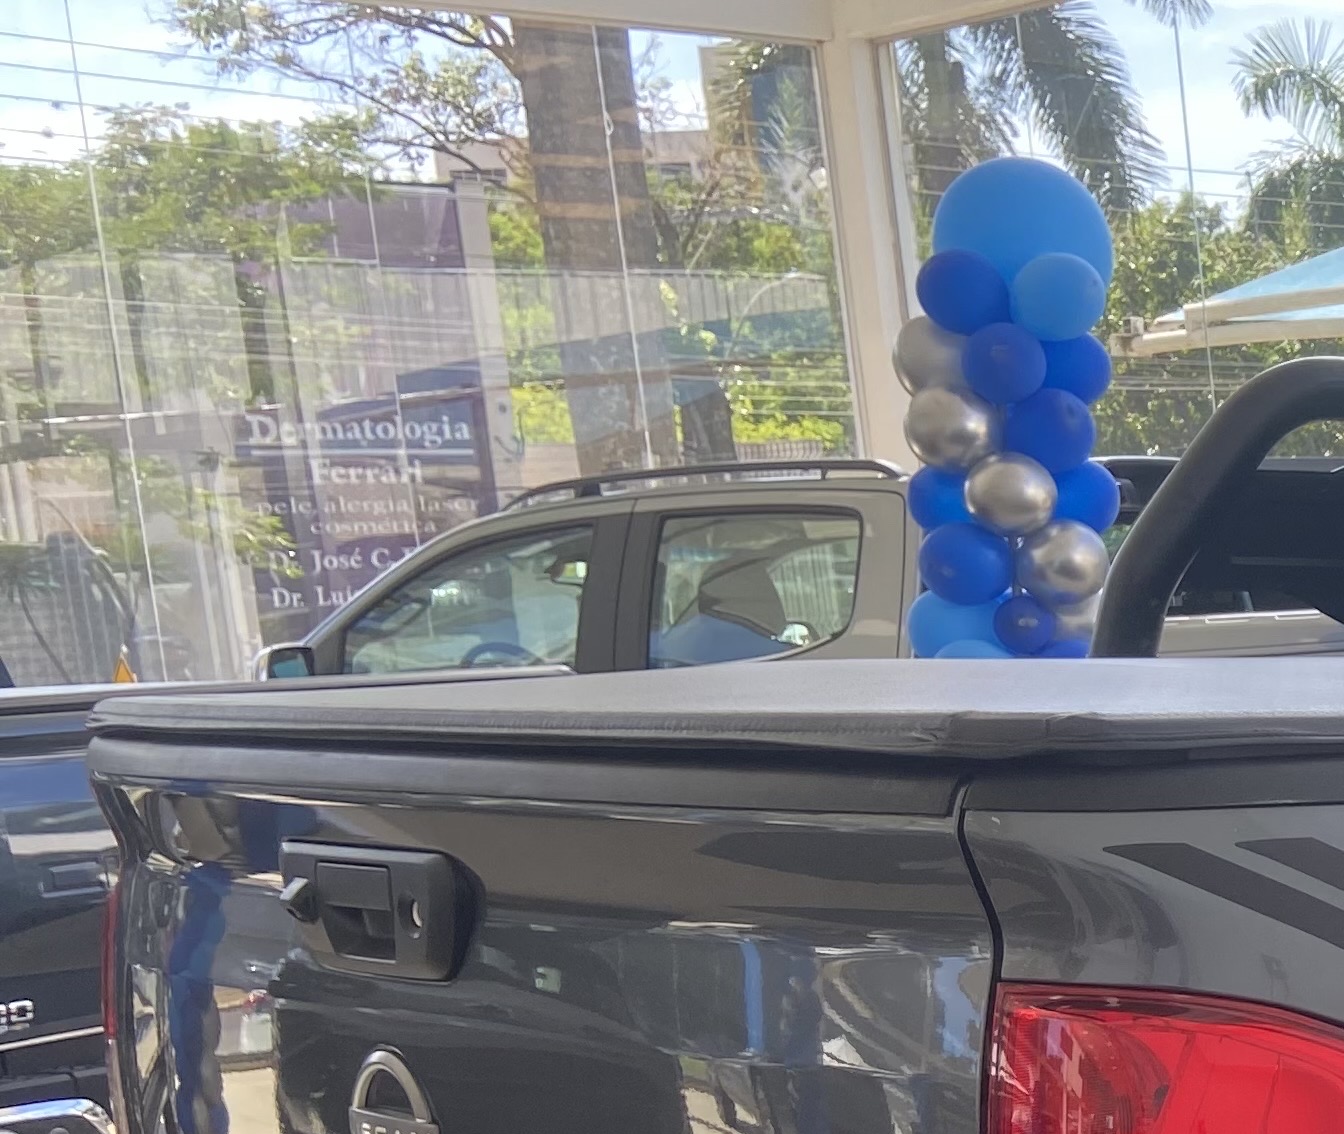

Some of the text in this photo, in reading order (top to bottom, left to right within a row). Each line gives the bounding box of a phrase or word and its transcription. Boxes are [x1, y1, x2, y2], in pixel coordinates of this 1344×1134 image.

[247, 415, 471, 447] Dermatologia
[311, 547, 363, 574] José
[271, 587, 305, 609] Dr.
